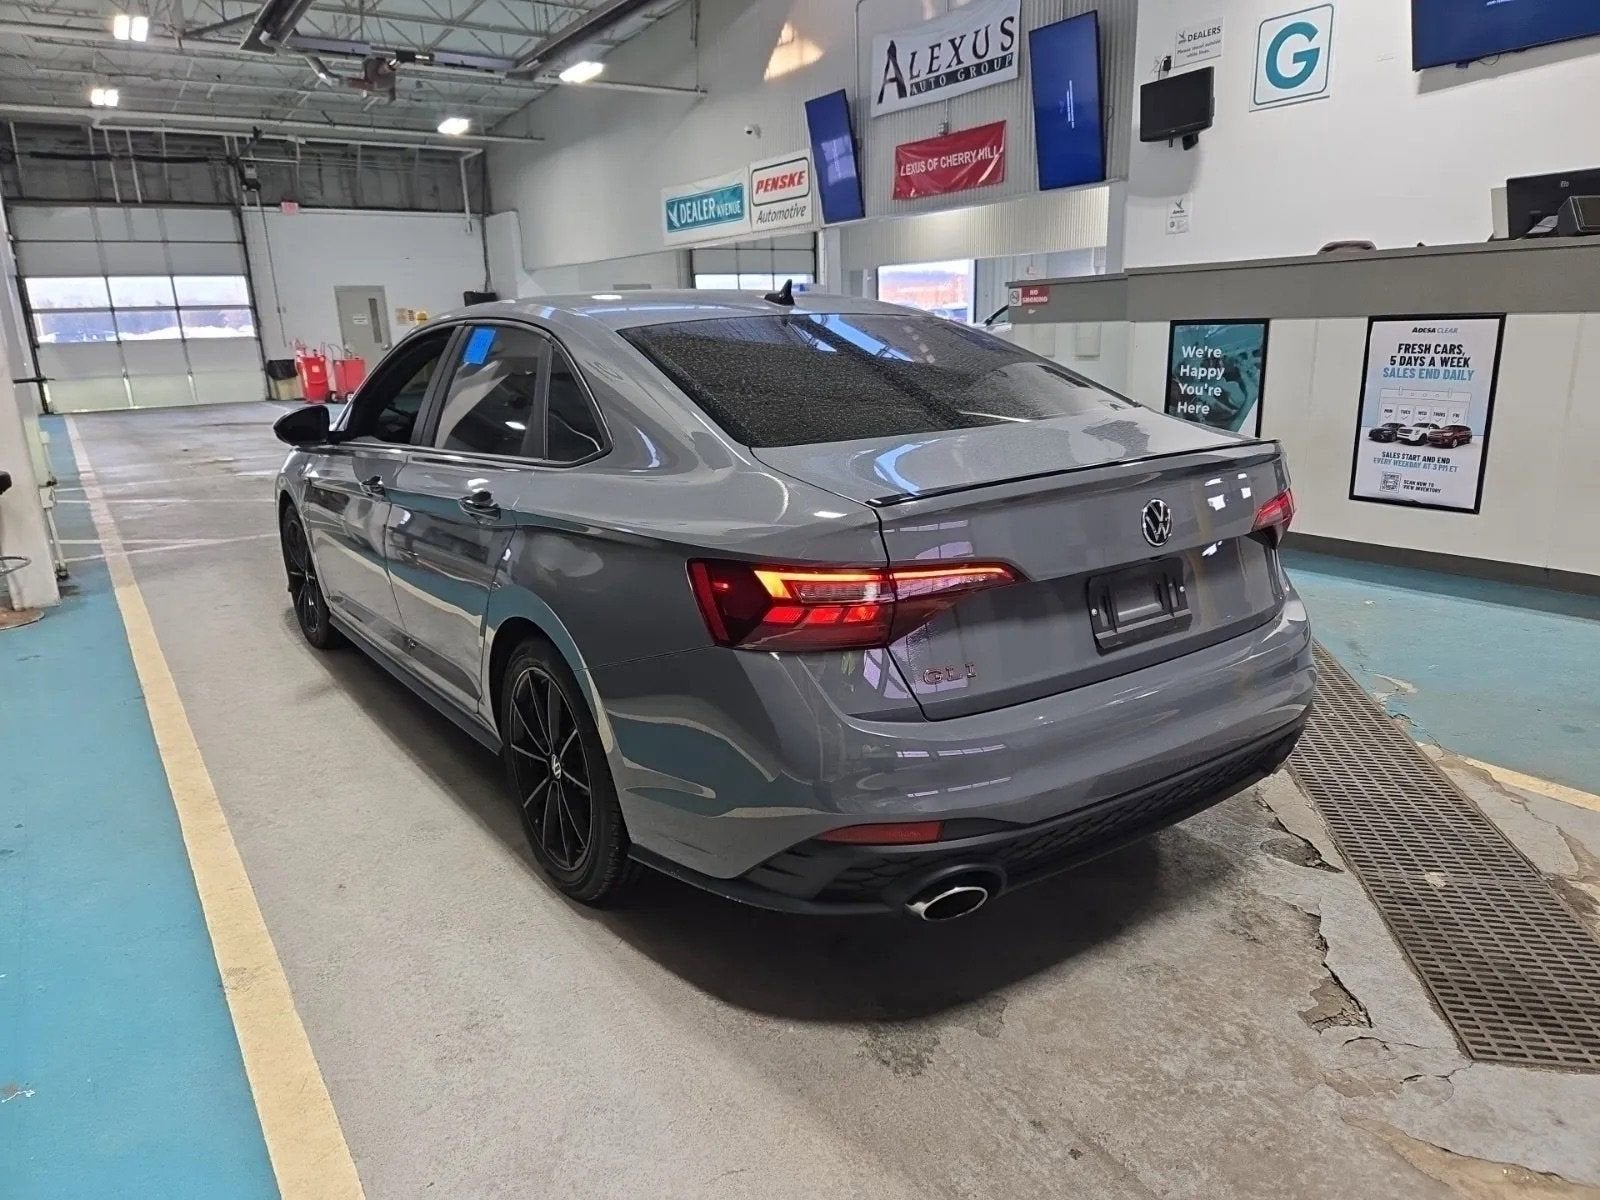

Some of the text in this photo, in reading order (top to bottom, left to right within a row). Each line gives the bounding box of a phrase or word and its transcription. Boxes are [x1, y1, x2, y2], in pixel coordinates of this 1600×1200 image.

[1187, 26, 1221, 42] DEALERS
[877, 16, 1015, 104] ALEXUS
[1265, 21, 1320, 89] G
[910, 54, 1013, 95] AUTO GROUP
[900, 145, 998, 176] LEXUS OF CHERRY HILL
[756, 170, 806, 194] PENSKE
[680, 197, 741, 224] DEALER AVENUE
[757, 203, 807, 224] Automotive
[1181, 345, 1222, 358] We're
[1398, 343, 1466, 357] FRESH CARS,
[1390, 356, 1471, 368] 5 DAYS A WEEK
[1180, 364, 1226, 380] Happy
[1383, 367, 1475, 381] SALES END DAILY
[1178, 383, 1223, 396] You're
[1177, 401, 1210, 415] Here
[1373, 457, 1393, 465] EVERY
[1393, 459, 1421, 469] WEEKDAY
[1422, 462, 1432, 470] AT
[1438, 464, 1448, 472] PM
[1449, 465, 1459, 473] ET
[1382, 451, 1401, 460] SALES
[1401, 453, 1421, 461] START
[1437, 457, 1451, 465] END
[923, 663, 977, 685] GLI
